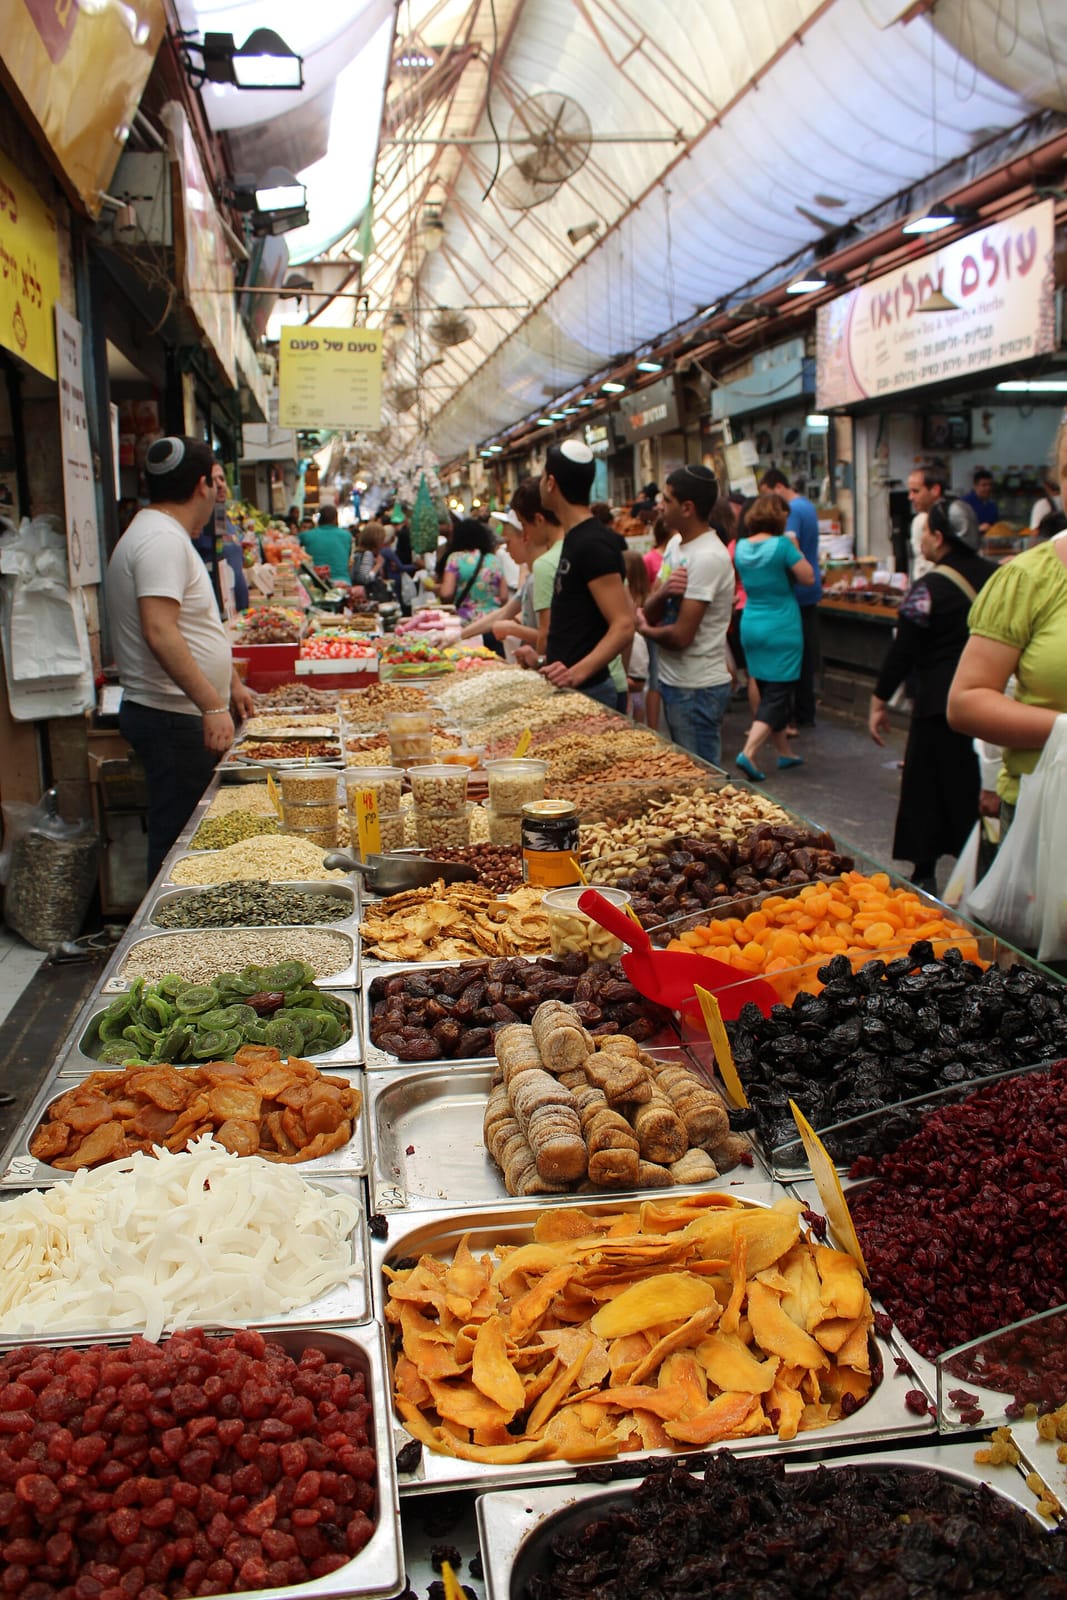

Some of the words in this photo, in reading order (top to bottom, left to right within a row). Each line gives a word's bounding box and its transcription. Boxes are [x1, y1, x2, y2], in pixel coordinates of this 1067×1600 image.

[961, 226, 1037, 298] עולם
[871, 267, 945, 330] ומלואו
[289, 339, 319, 351] פעם
[323, 338, 344, 352] של
